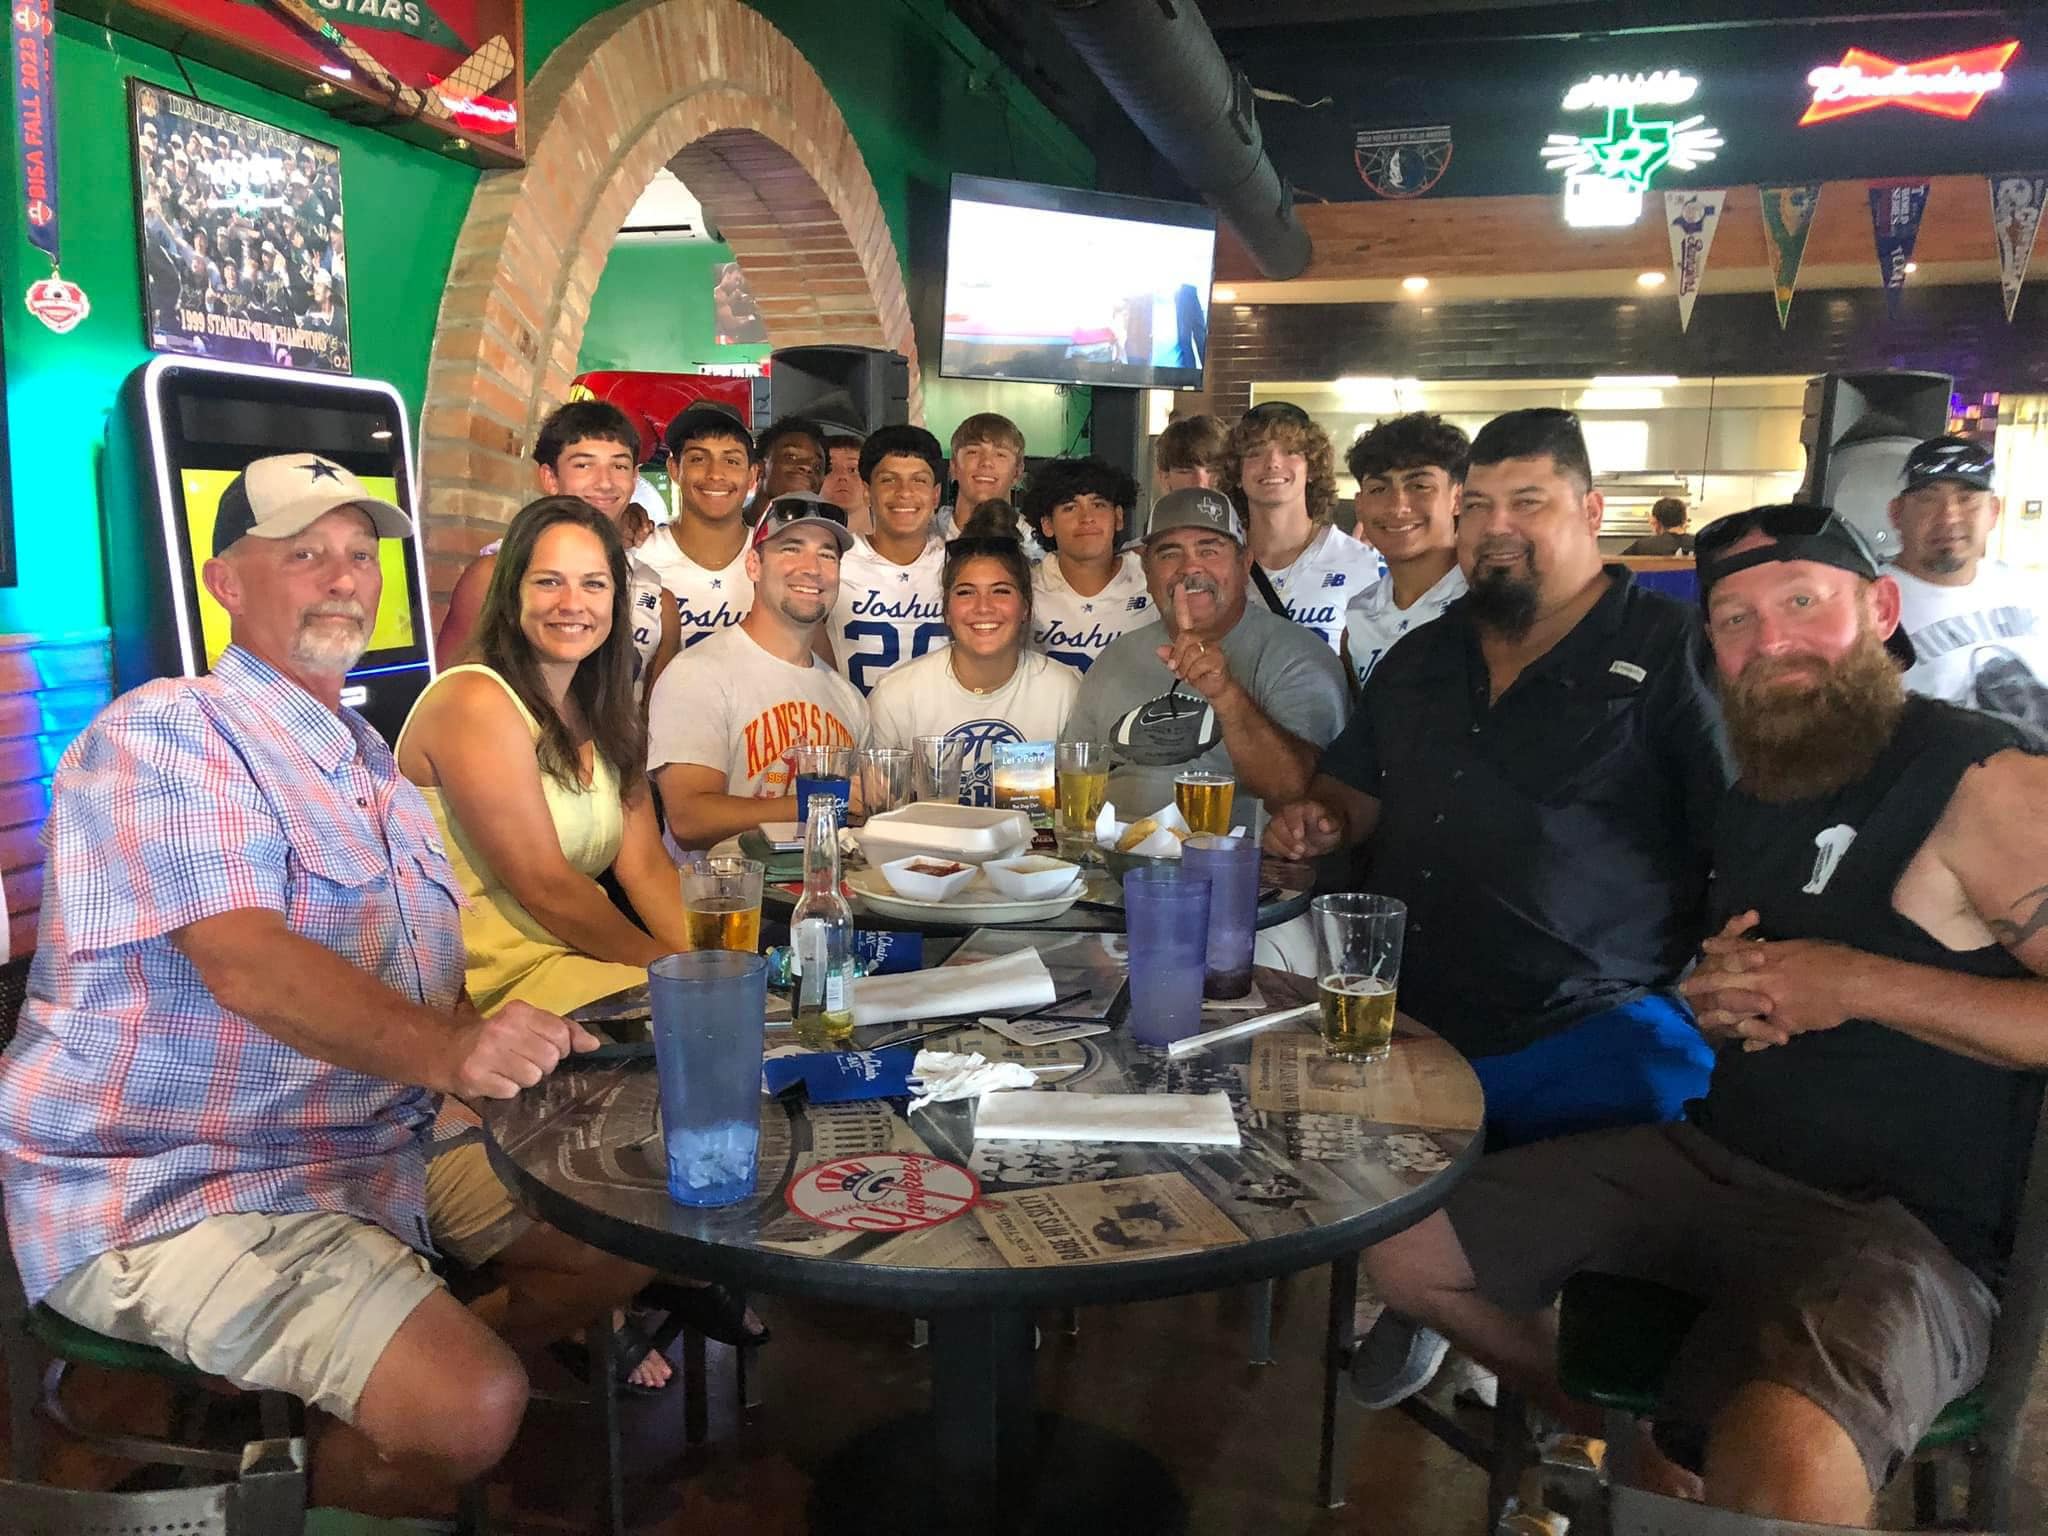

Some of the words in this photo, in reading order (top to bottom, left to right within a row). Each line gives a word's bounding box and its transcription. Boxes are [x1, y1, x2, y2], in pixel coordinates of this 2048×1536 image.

[19, 38, 40, 90] 2023
[22, 95, 44, 146] FALL
[168, 95, 240, 135] DALLAS
[246, 121, 301, 154] STARS
[26, 150, 47, 200] DISA
[180, 308, 206, 333] 1999
[207, 313, 250, 340] STANLEY
[275, 323, 328, 351] CHAMPIONS
[675, 597, 750, 627] Joshu
[851, 589, 945, 618] Joshu
[1284, 599, 1337, 623] hua
[1034, 620, 1122, 648] Joshu
[744, 701, 822, 781] KANSAS
[1013, 1194, 1054, 1218] SIXTY
[1033, 1217, 1071, 1238] HITS
[1047, 1237, 1089, 1260] BABE
